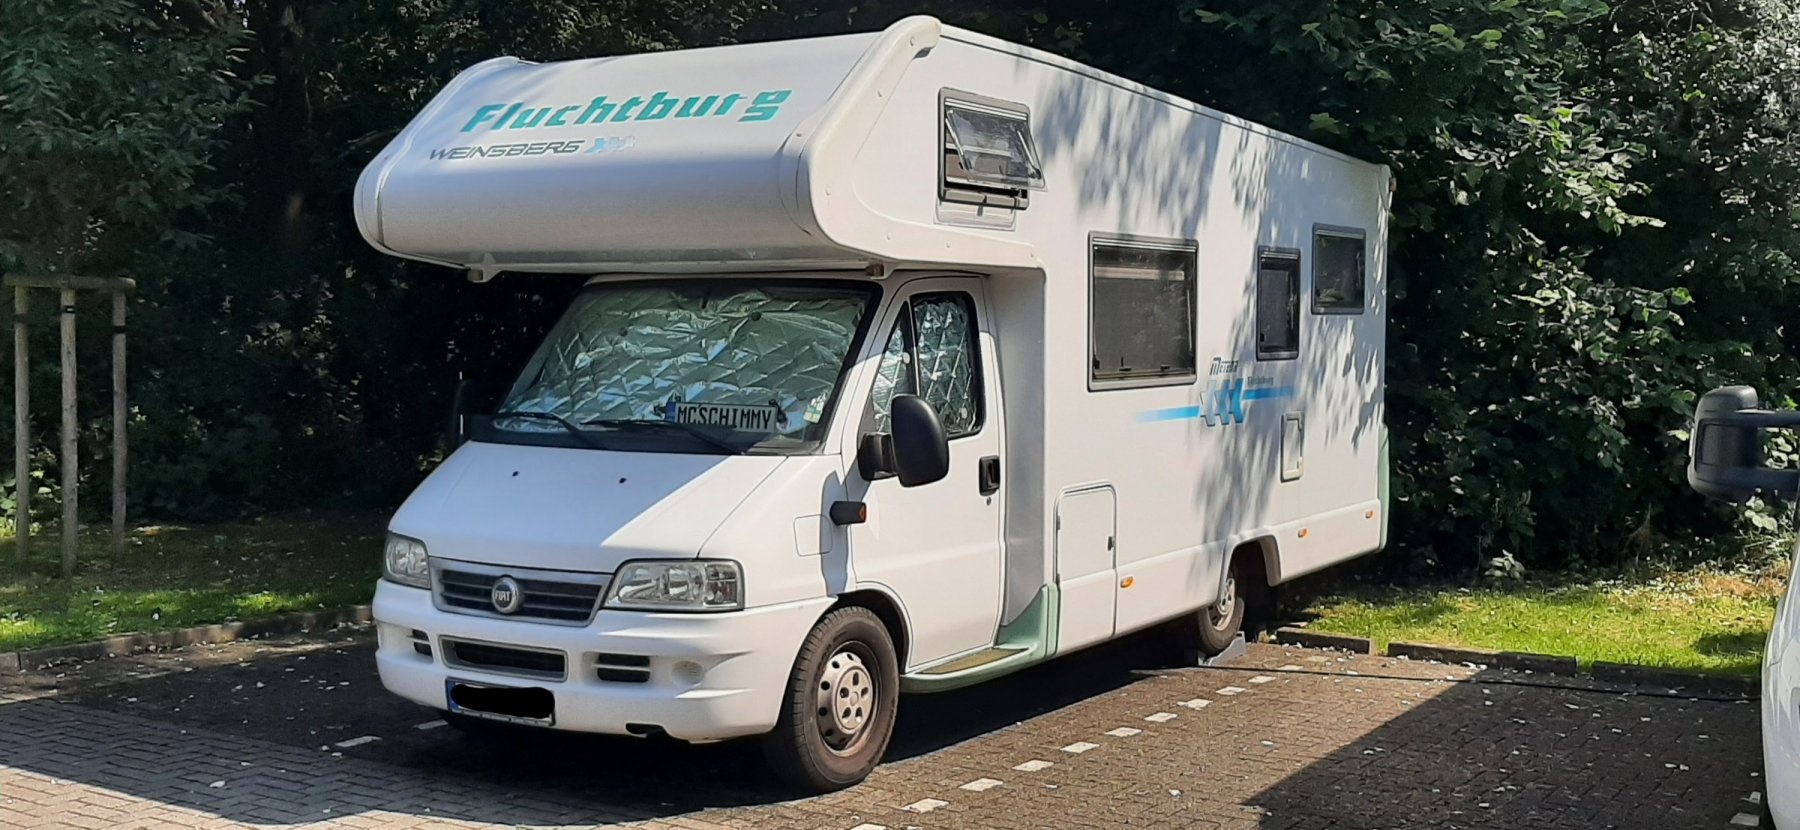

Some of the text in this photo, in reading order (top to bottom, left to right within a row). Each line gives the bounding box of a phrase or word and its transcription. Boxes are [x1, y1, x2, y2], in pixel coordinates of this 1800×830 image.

[460, 90, 792, 132] Fluchtburg
[430, 140, 585, 160] WEINSBERG
[678, 406, 772, 430] MCSCHIMMY
[495, 590, 510, 601] FIAT
